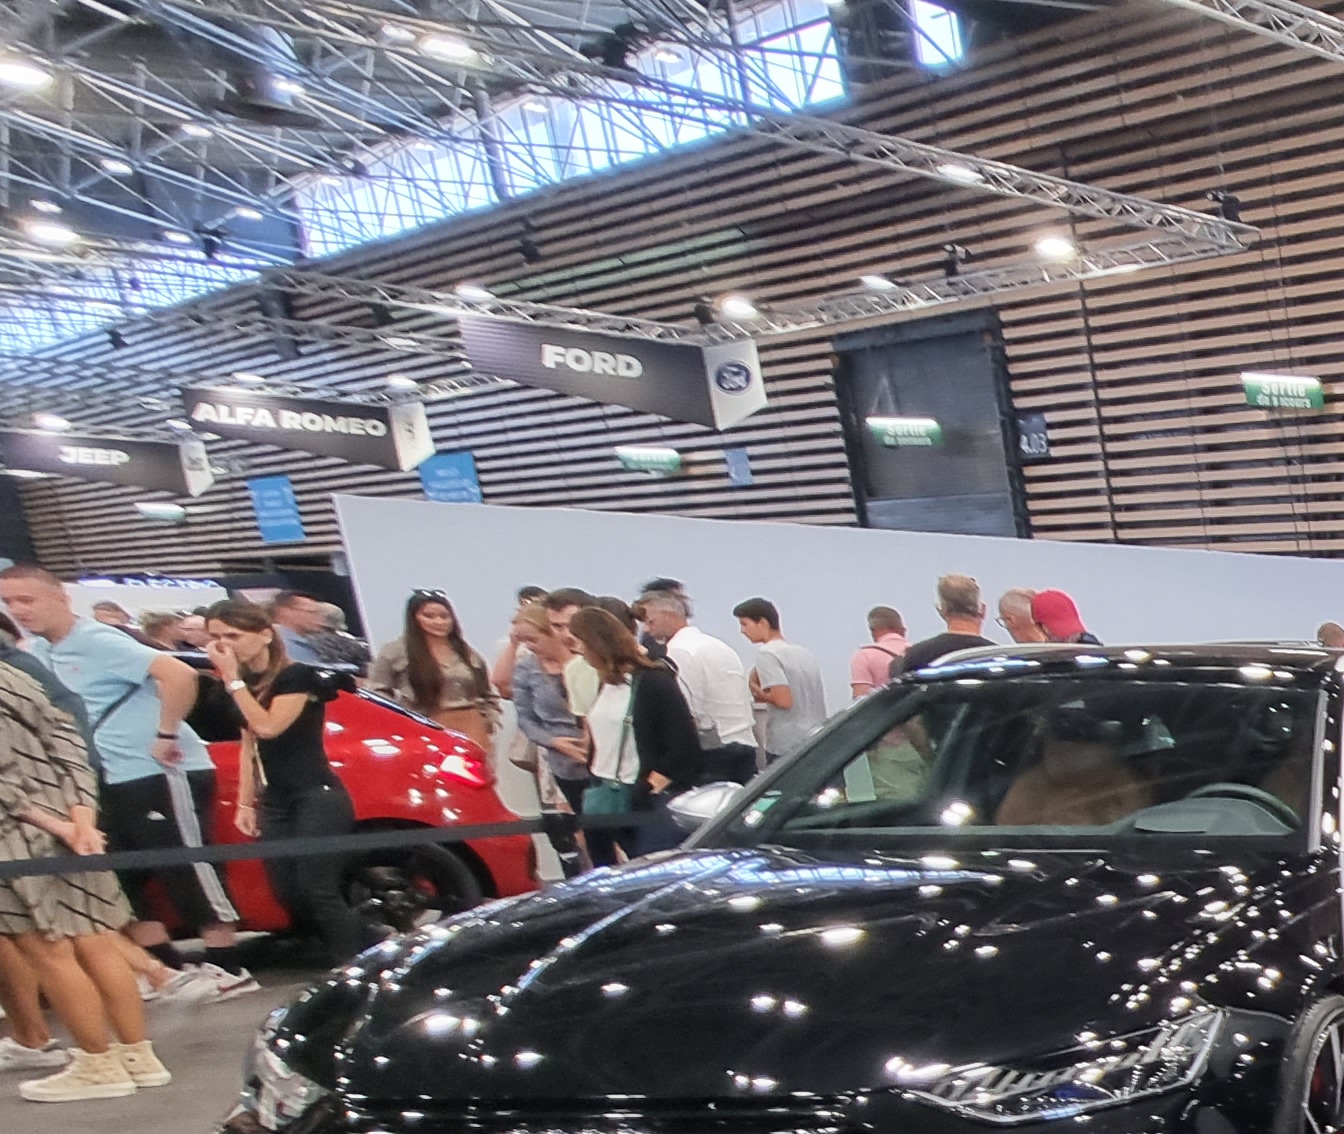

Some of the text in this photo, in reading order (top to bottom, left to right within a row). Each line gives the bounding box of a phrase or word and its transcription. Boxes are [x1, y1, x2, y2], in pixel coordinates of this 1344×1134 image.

[541, 343, 643, 378] FORD
[1260, 381, 1307, 397] Sortie
[192, 402, 388, 437] ALFA ROMEO
[58, 445, 130, 466] JEEP
